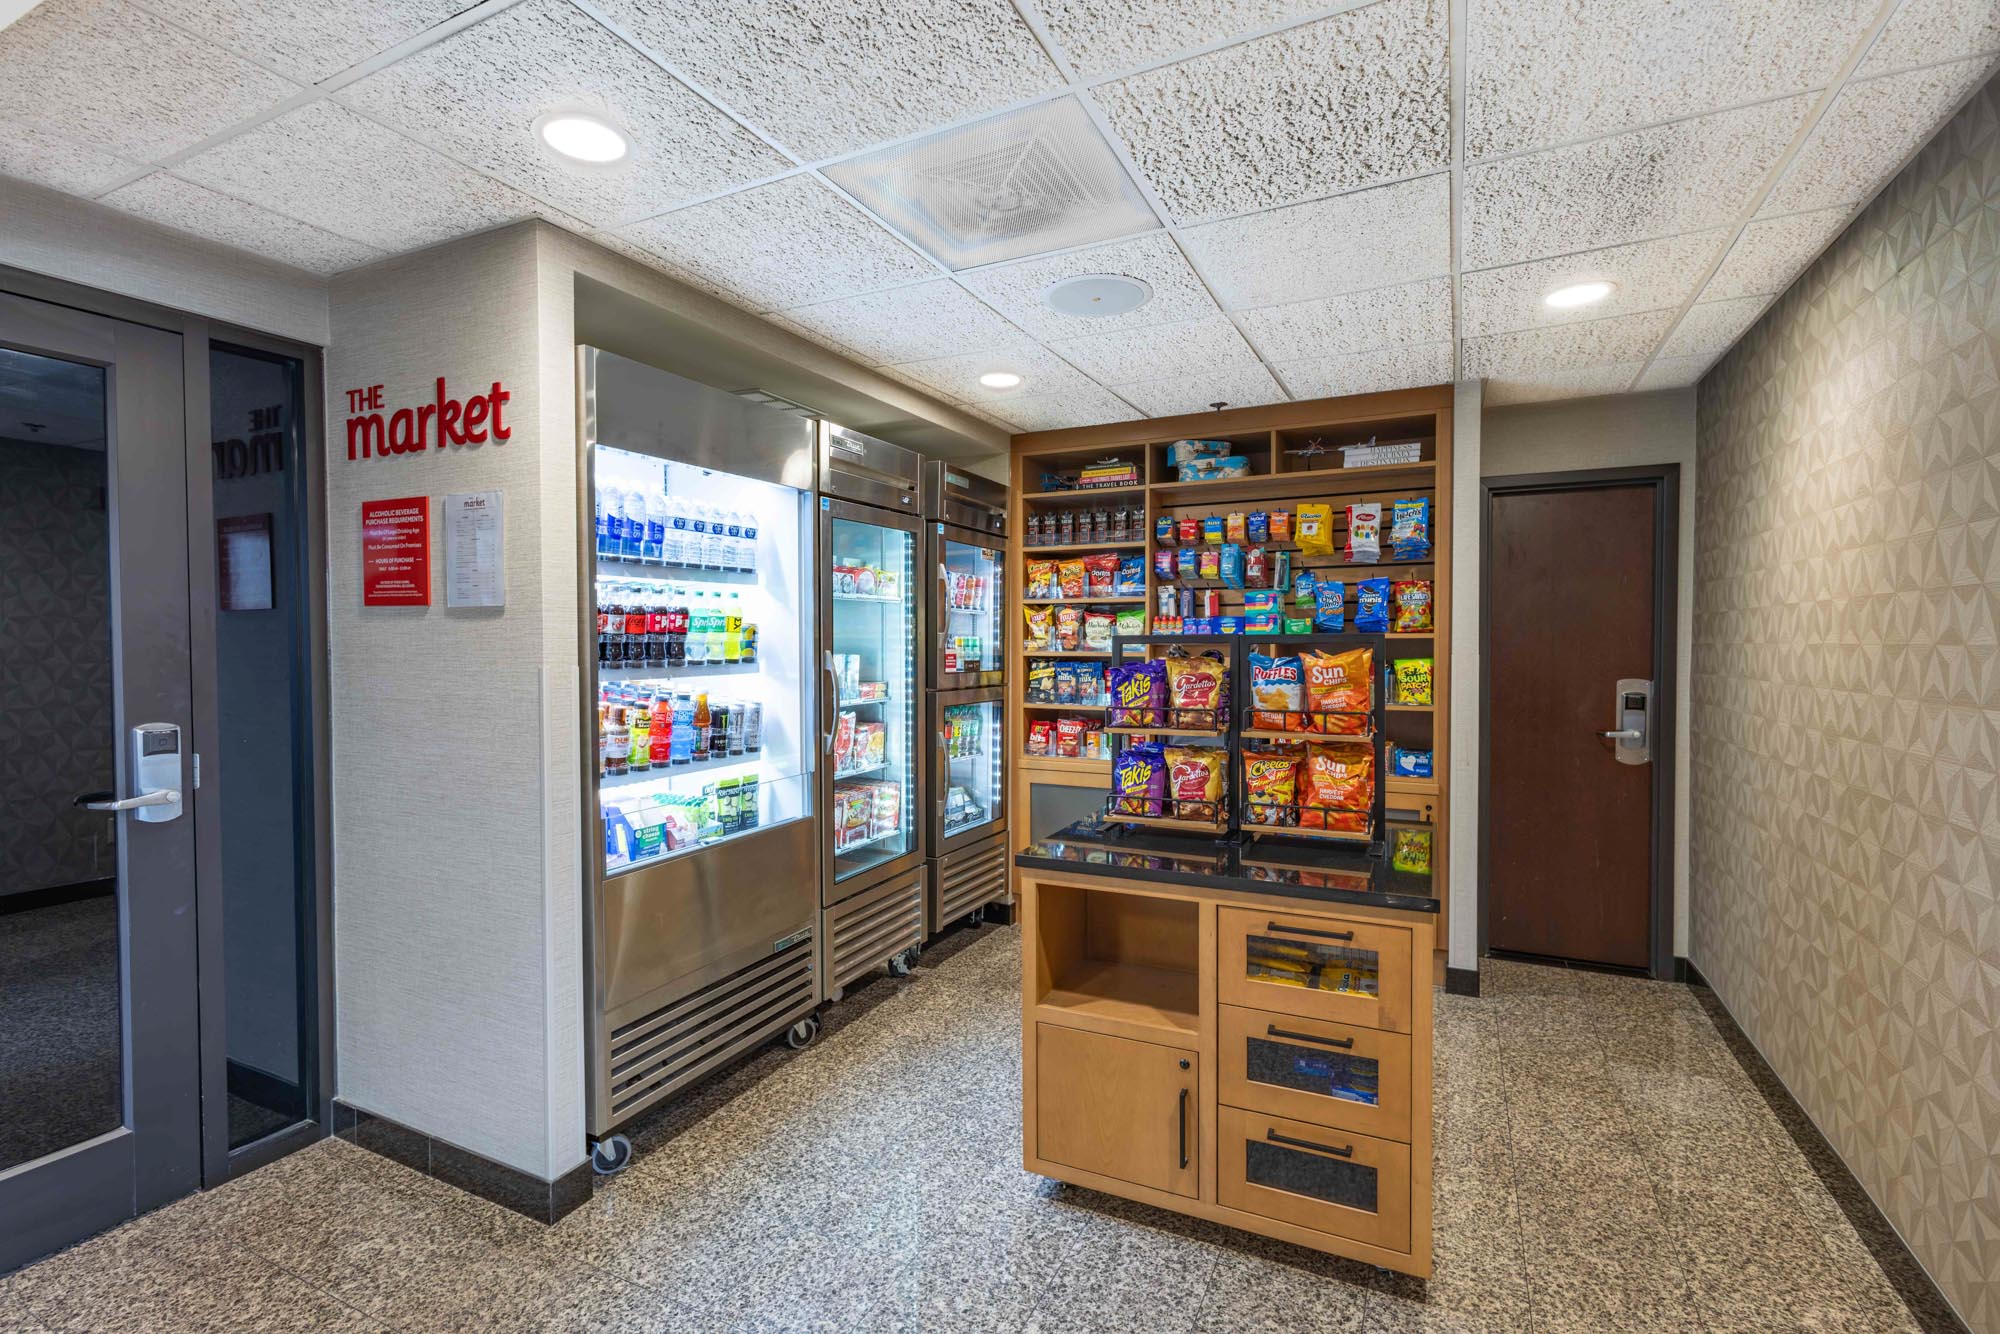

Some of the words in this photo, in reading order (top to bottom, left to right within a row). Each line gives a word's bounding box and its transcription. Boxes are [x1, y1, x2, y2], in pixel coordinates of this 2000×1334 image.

[346, 384, 385, 413] THE
[346, 377, 511, 460] market
[366, 517, 389, 525] PURCHASE
[389, 515, 424, 524] REQUIREMENTS
[1253, 666, 1297, 681] RUFFLES
[1312, 666, 1344, 684] Sun
[1401, 675, 1427, 683] SOUR
[1117, 674, 1151, 707] Takis
[1175, 675, 1216, 702] Gardetto's
[1320, 697, 1345, 705] HARVEST
[1251, 761, 1291, 777] Cheetos
[1316, 755, 1346, 772] Sun
[1120, 762, 1152, 790] Takis
